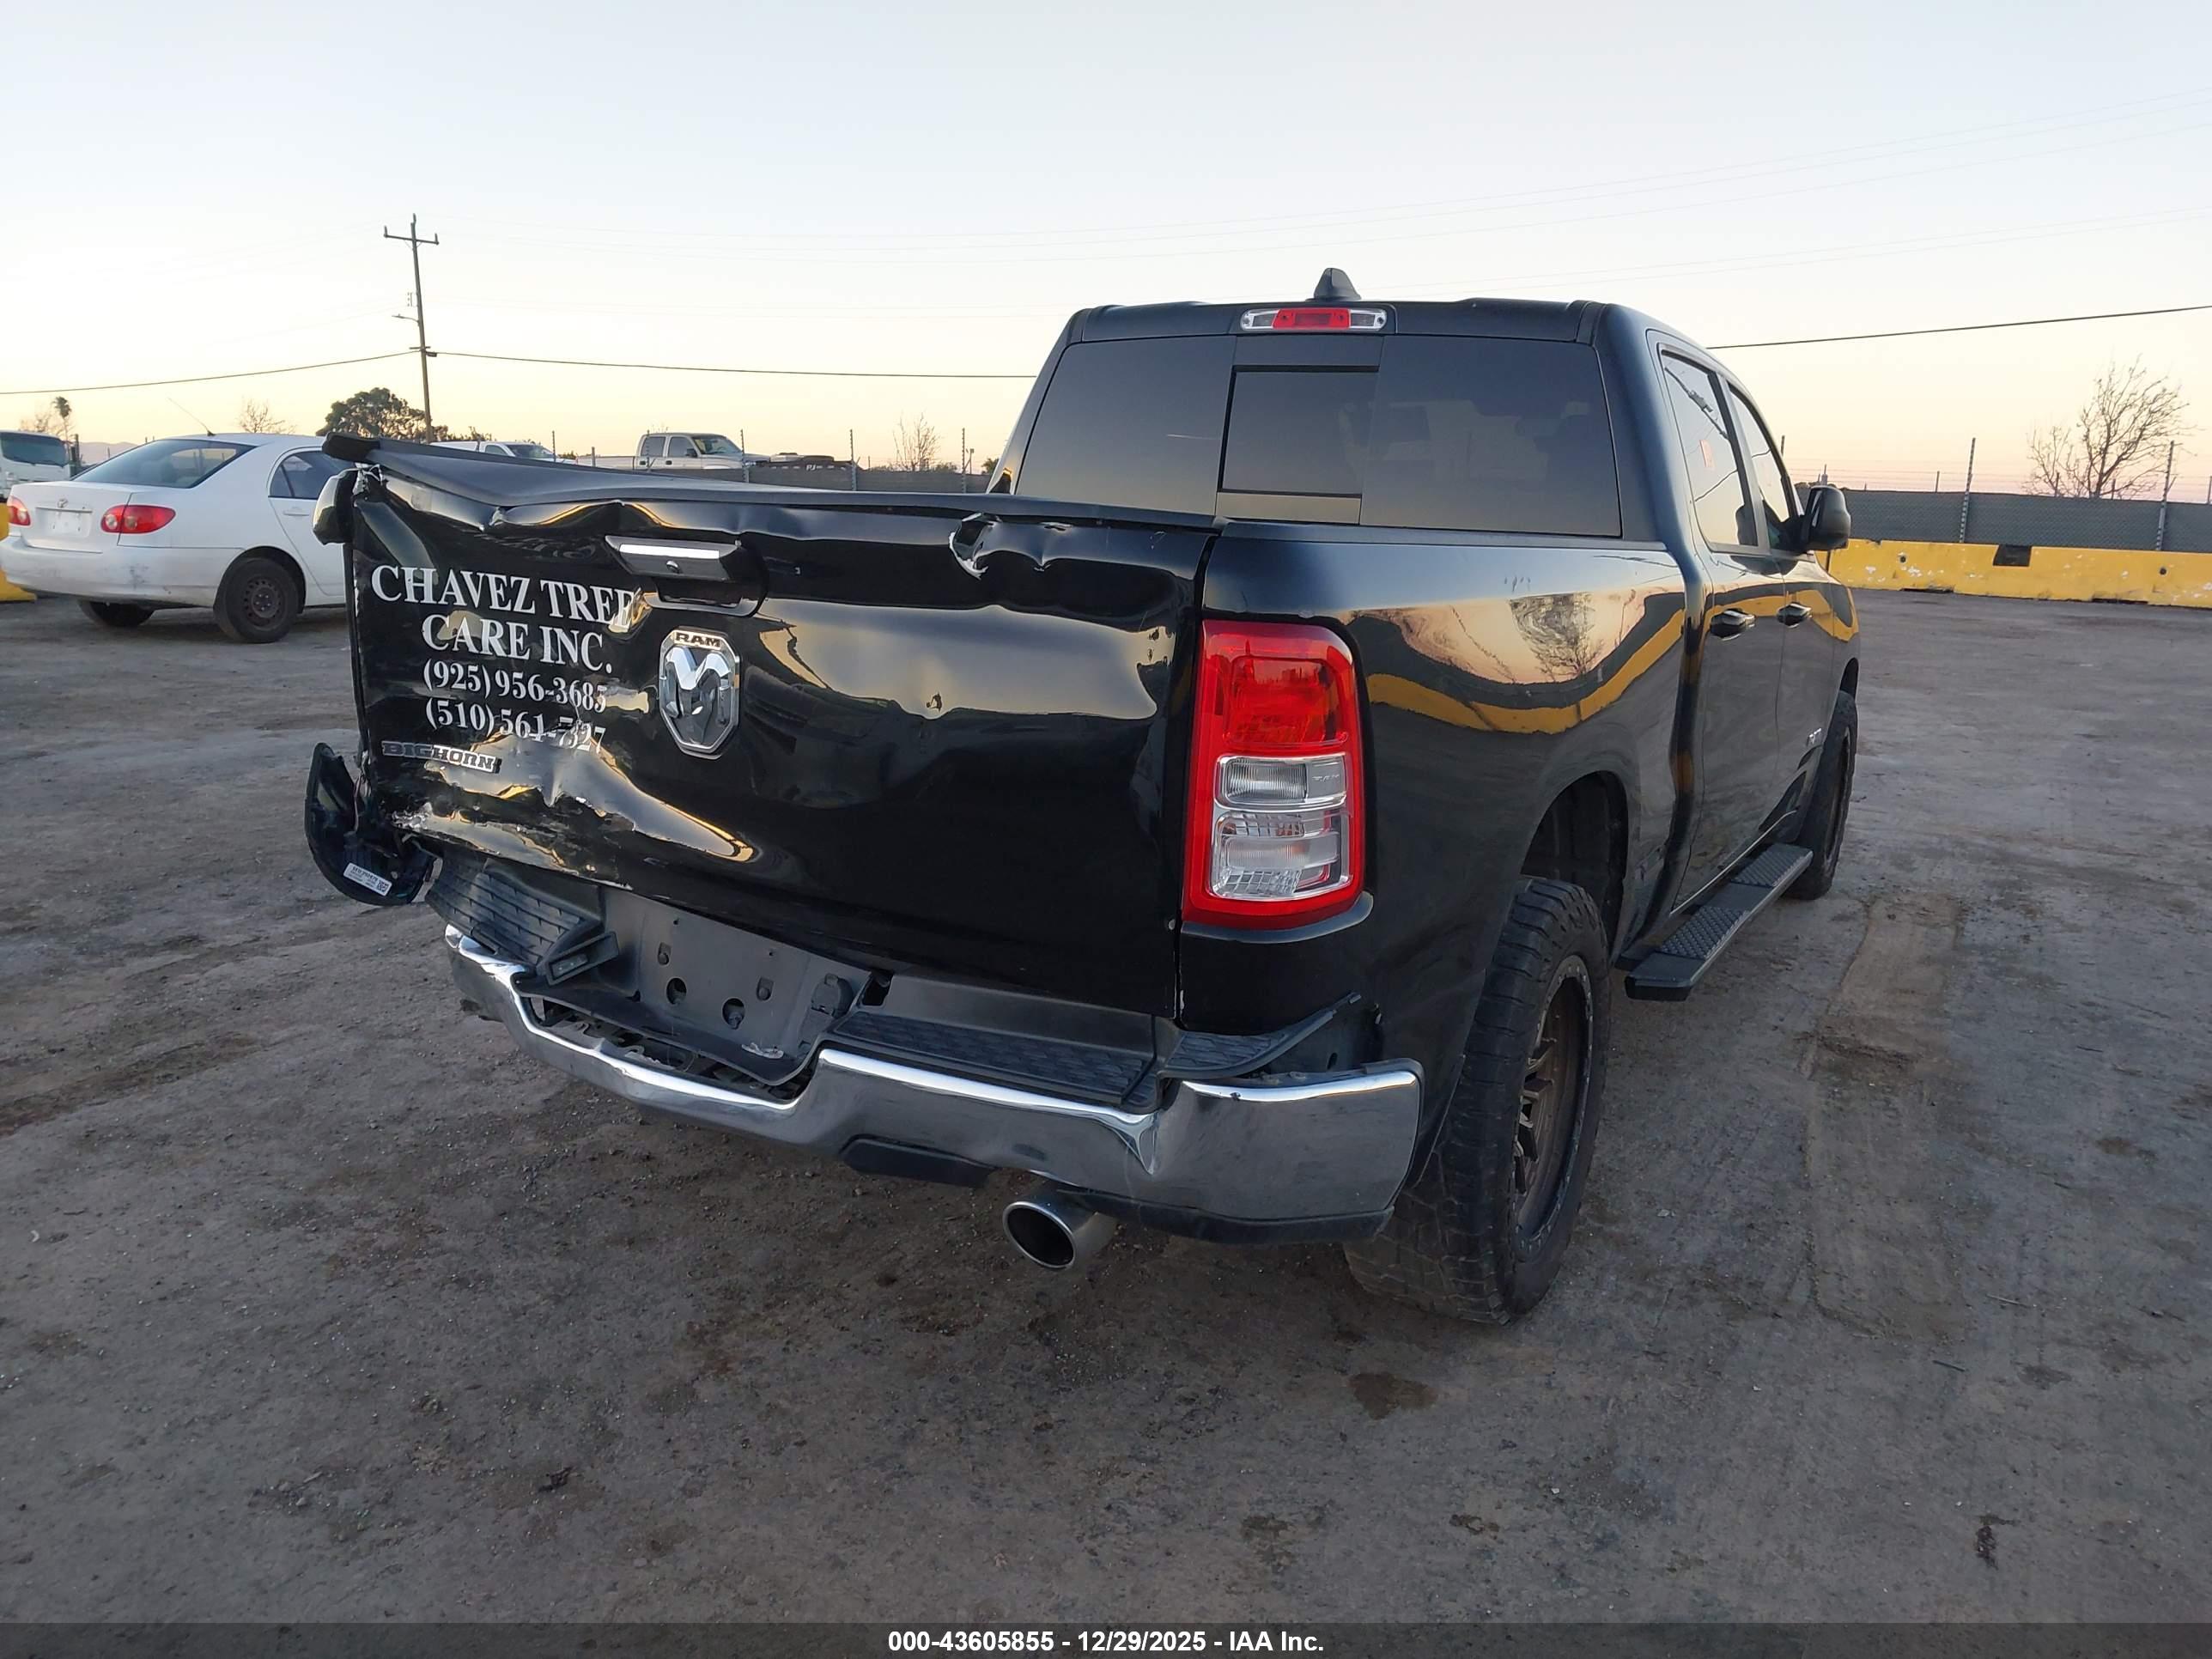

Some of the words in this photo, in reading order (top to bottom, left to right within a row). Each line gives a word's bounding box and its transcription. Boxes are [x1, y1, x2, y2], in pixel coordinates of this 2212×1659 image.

[371, 564, 536, 615] CHAVEZ
[422, 614, 531, 660] CARE
[539, 625, 612, 674] INC.
[674, 632, 720, 647] RAM
